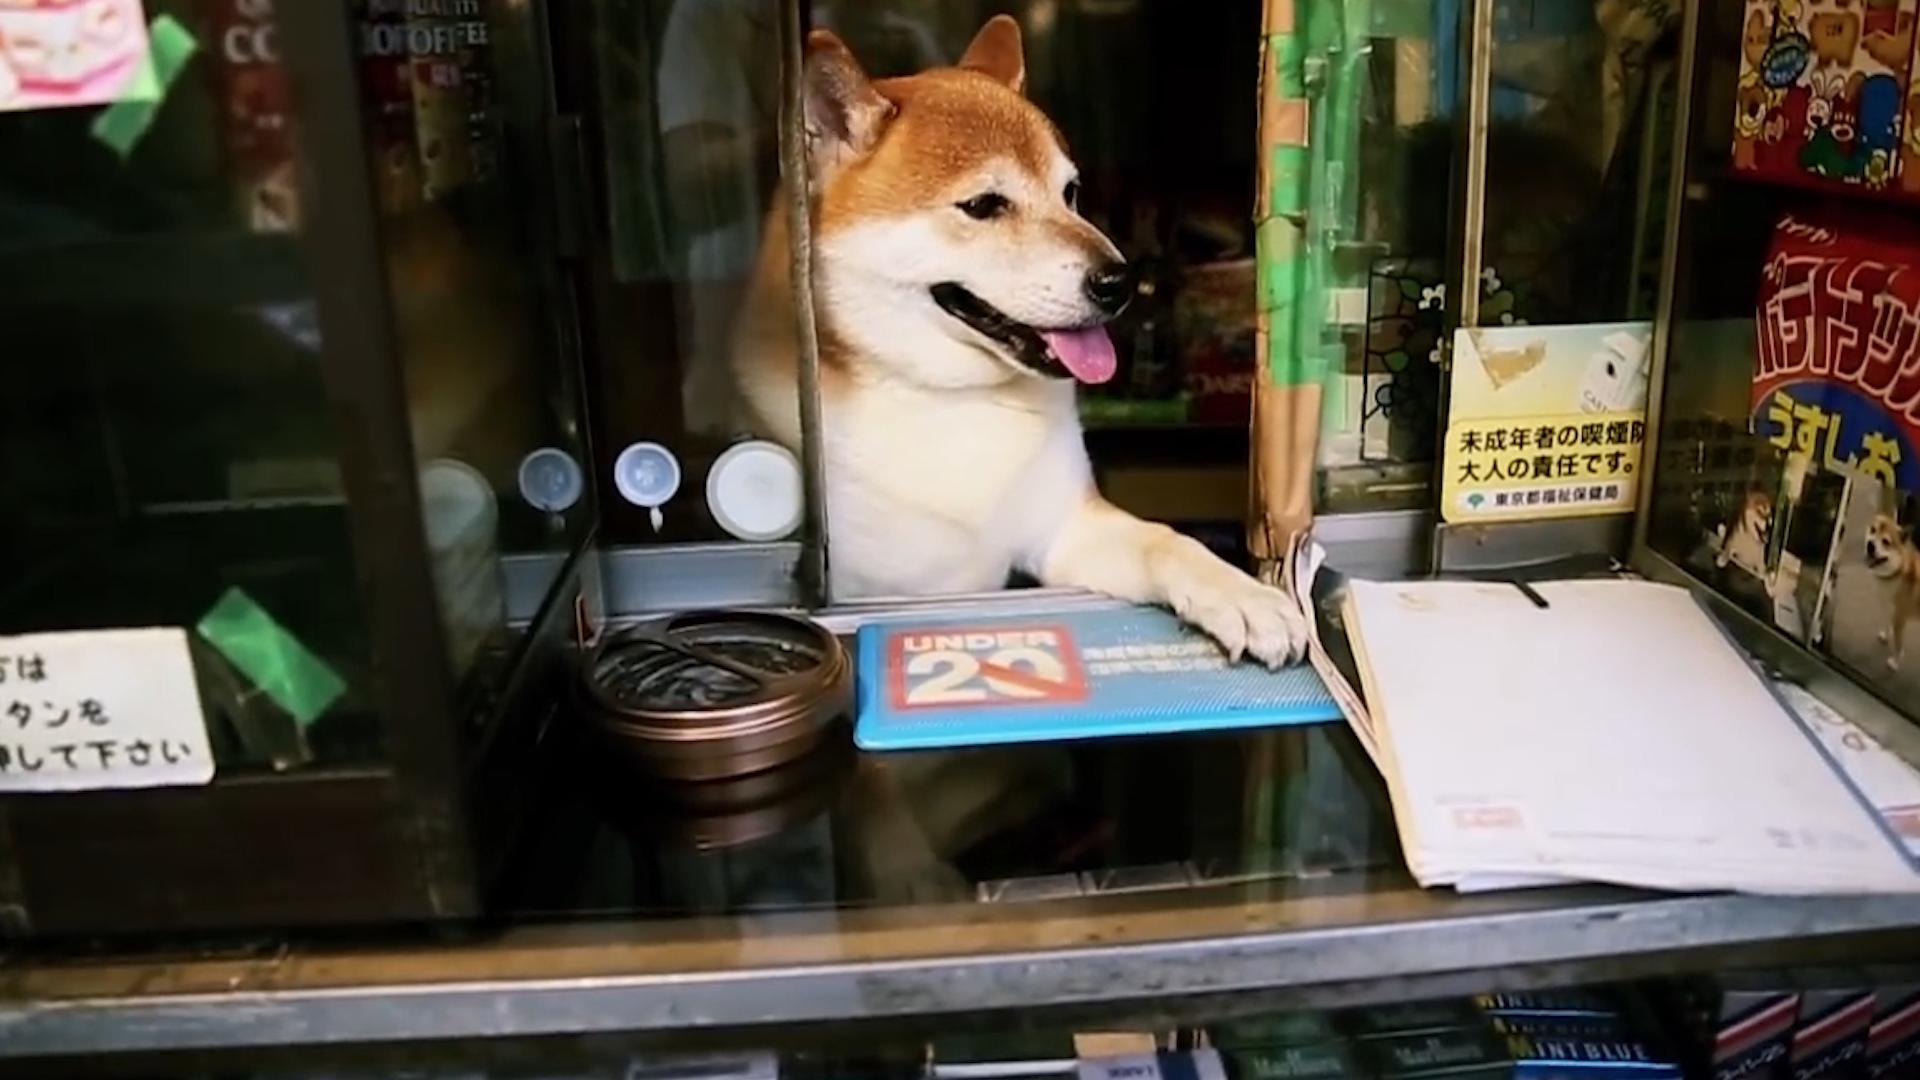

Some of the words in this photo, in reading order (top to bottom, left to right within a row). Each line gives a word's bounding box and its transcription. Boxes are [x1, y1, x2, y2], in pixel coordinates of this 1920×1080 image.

[1458, 450, 1633, 483] 大人の責任です。
[1494, 484, 1619, 507] 東京都福祉保健局
[1506, 1034, 1577, 1060] MINT
[1580, 1040, 1648, 1061] BLUE
